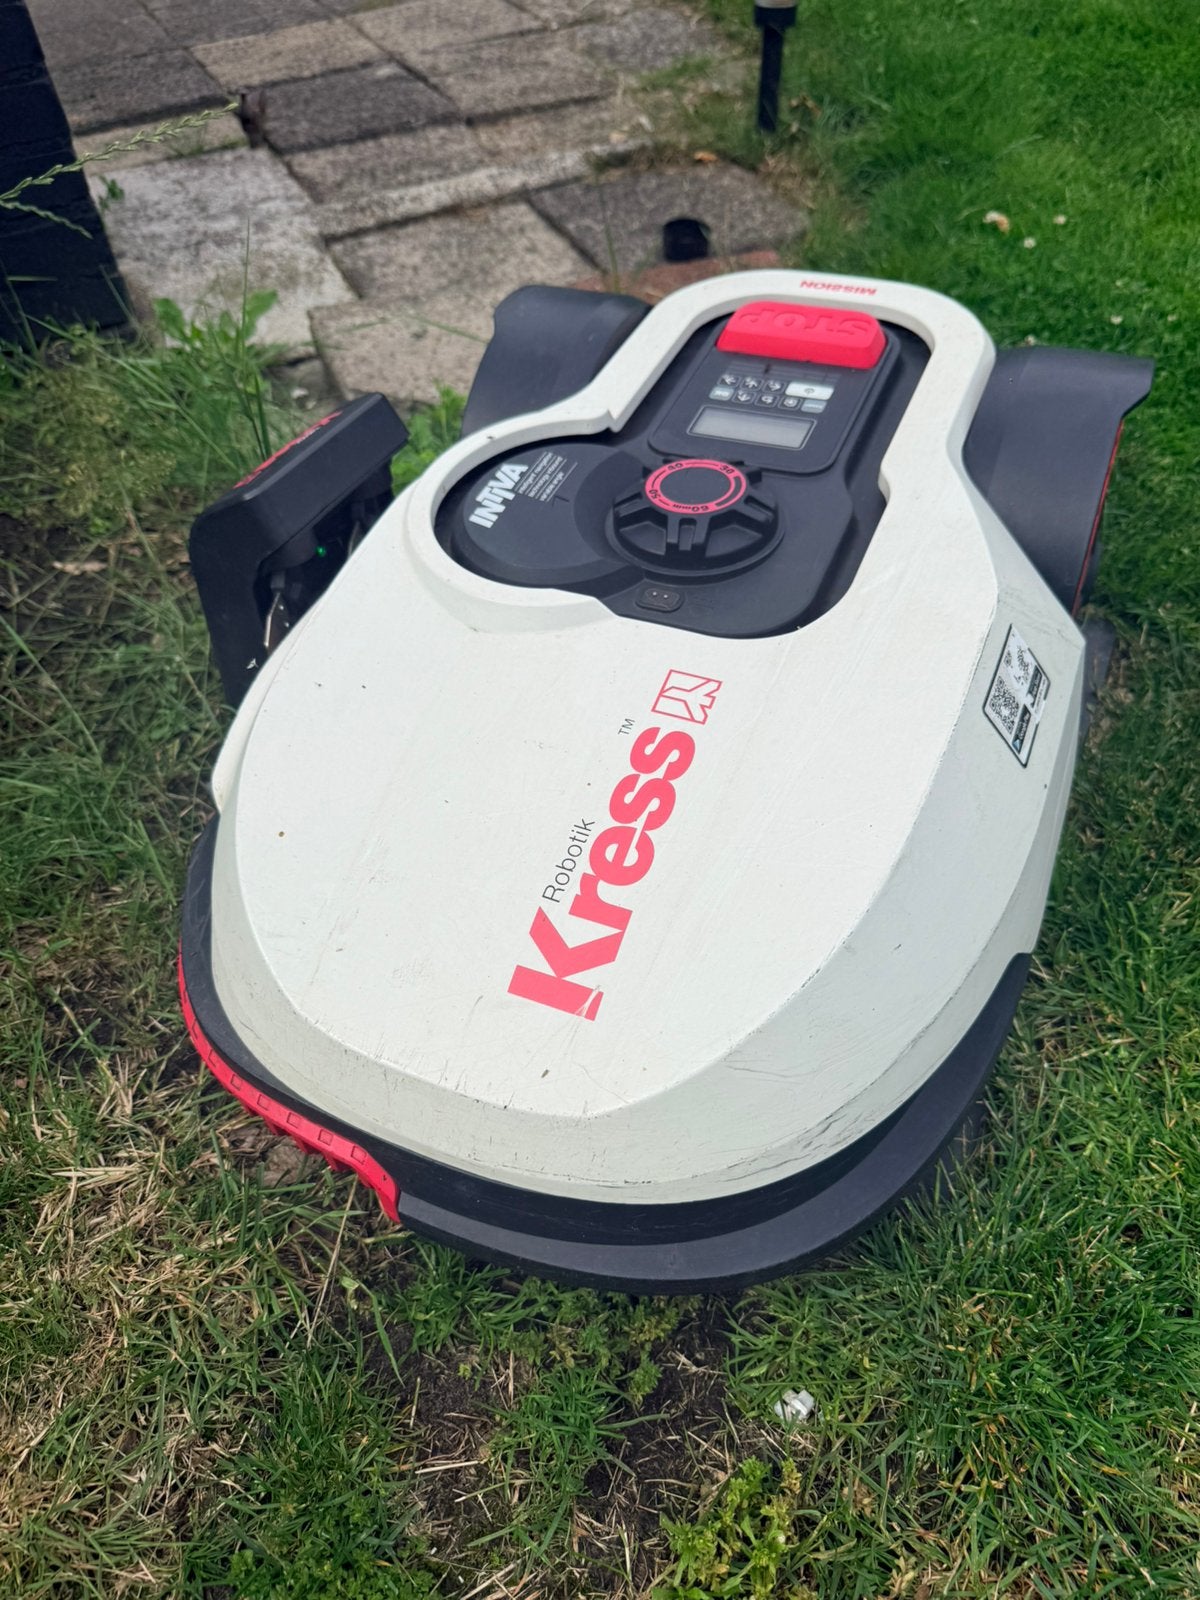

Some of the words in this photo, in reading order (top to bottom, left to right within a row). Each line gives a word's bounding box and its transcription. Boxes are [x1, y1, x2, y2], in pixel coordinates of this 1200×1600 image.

[800, 280, 877, 295] MISSION
[739, 307, 872, 336] STOP
[719, 465, 735, 474] 30
[649, 489, 661, 499] 50
[617, 718, 636, 736] TM
[542, 818, 596, 904] Robotik
[508, 726, 695, 1021] Kress
